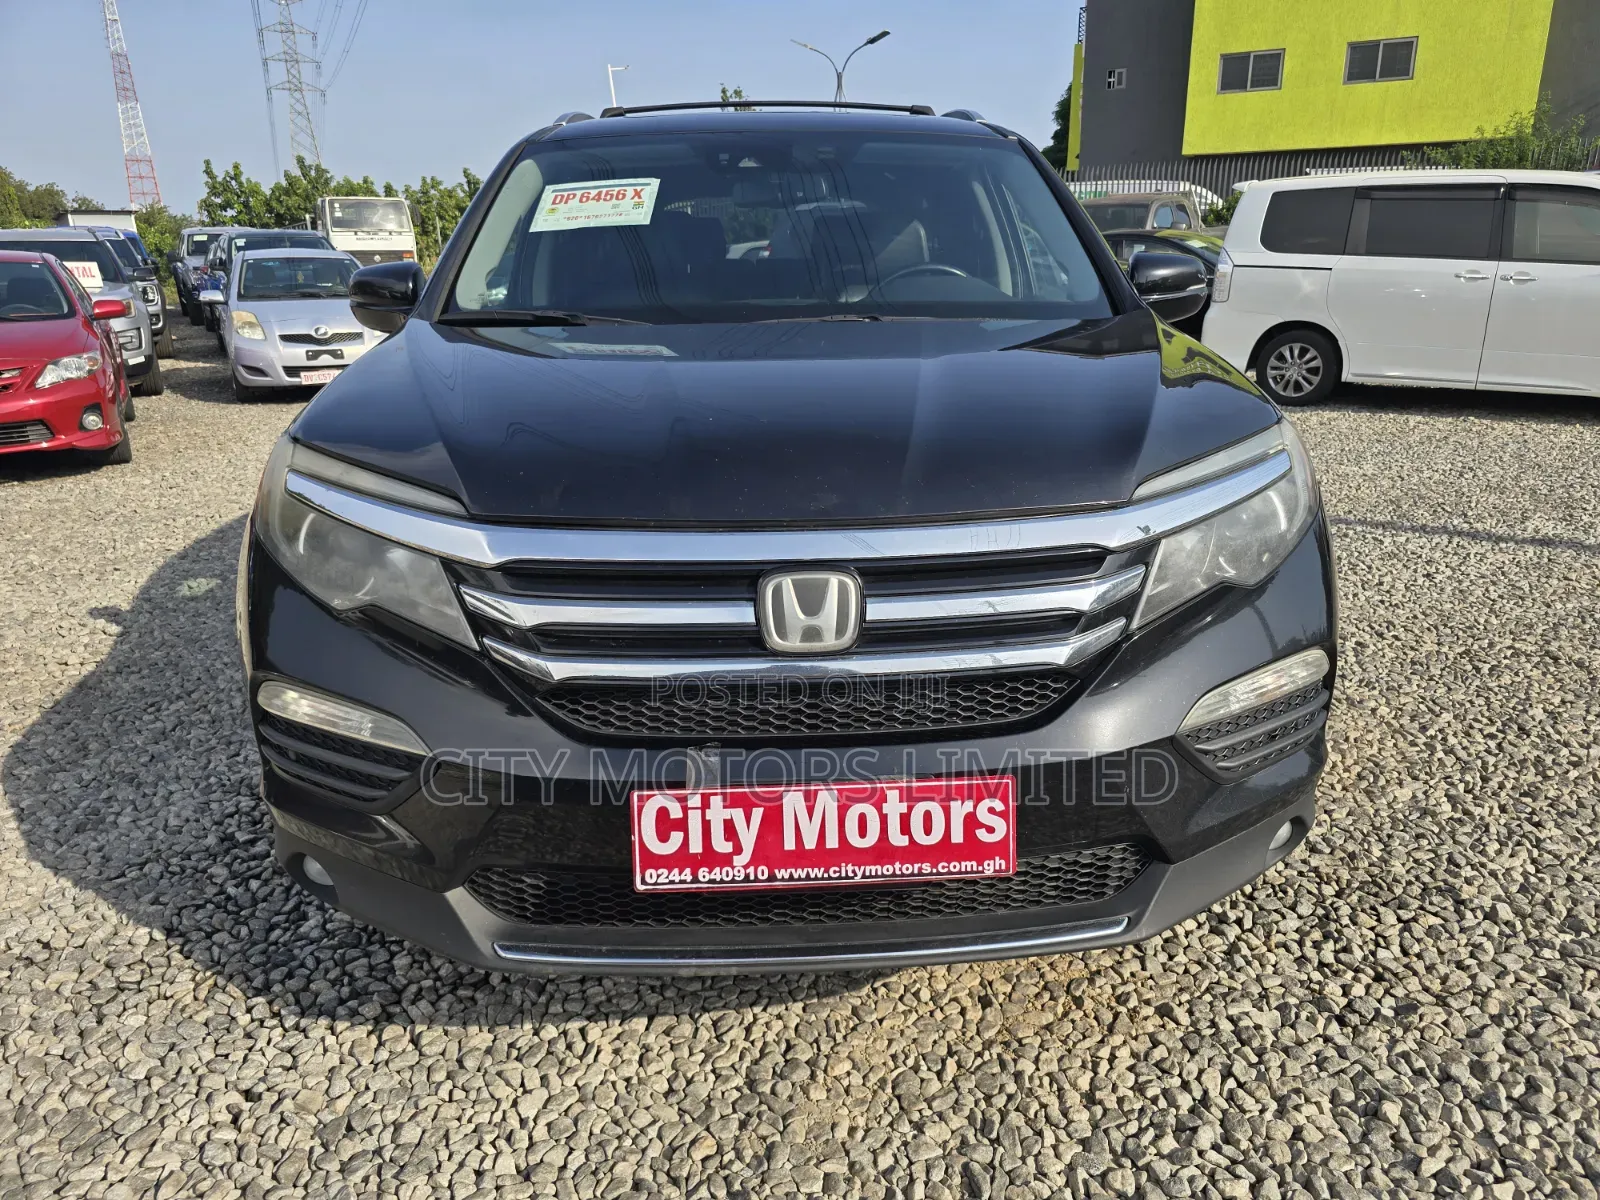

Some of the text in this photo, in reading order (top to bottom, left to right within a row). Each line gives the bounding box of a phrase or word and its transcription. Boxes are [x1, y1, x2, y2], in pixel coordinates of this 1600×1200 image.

[551, 188, 646, 206] DP 6456 X
[640, 789, 1008, 867] City Motors
[644, 856, 1006, 884] 0244 640910 www.citymotors.com.gh
